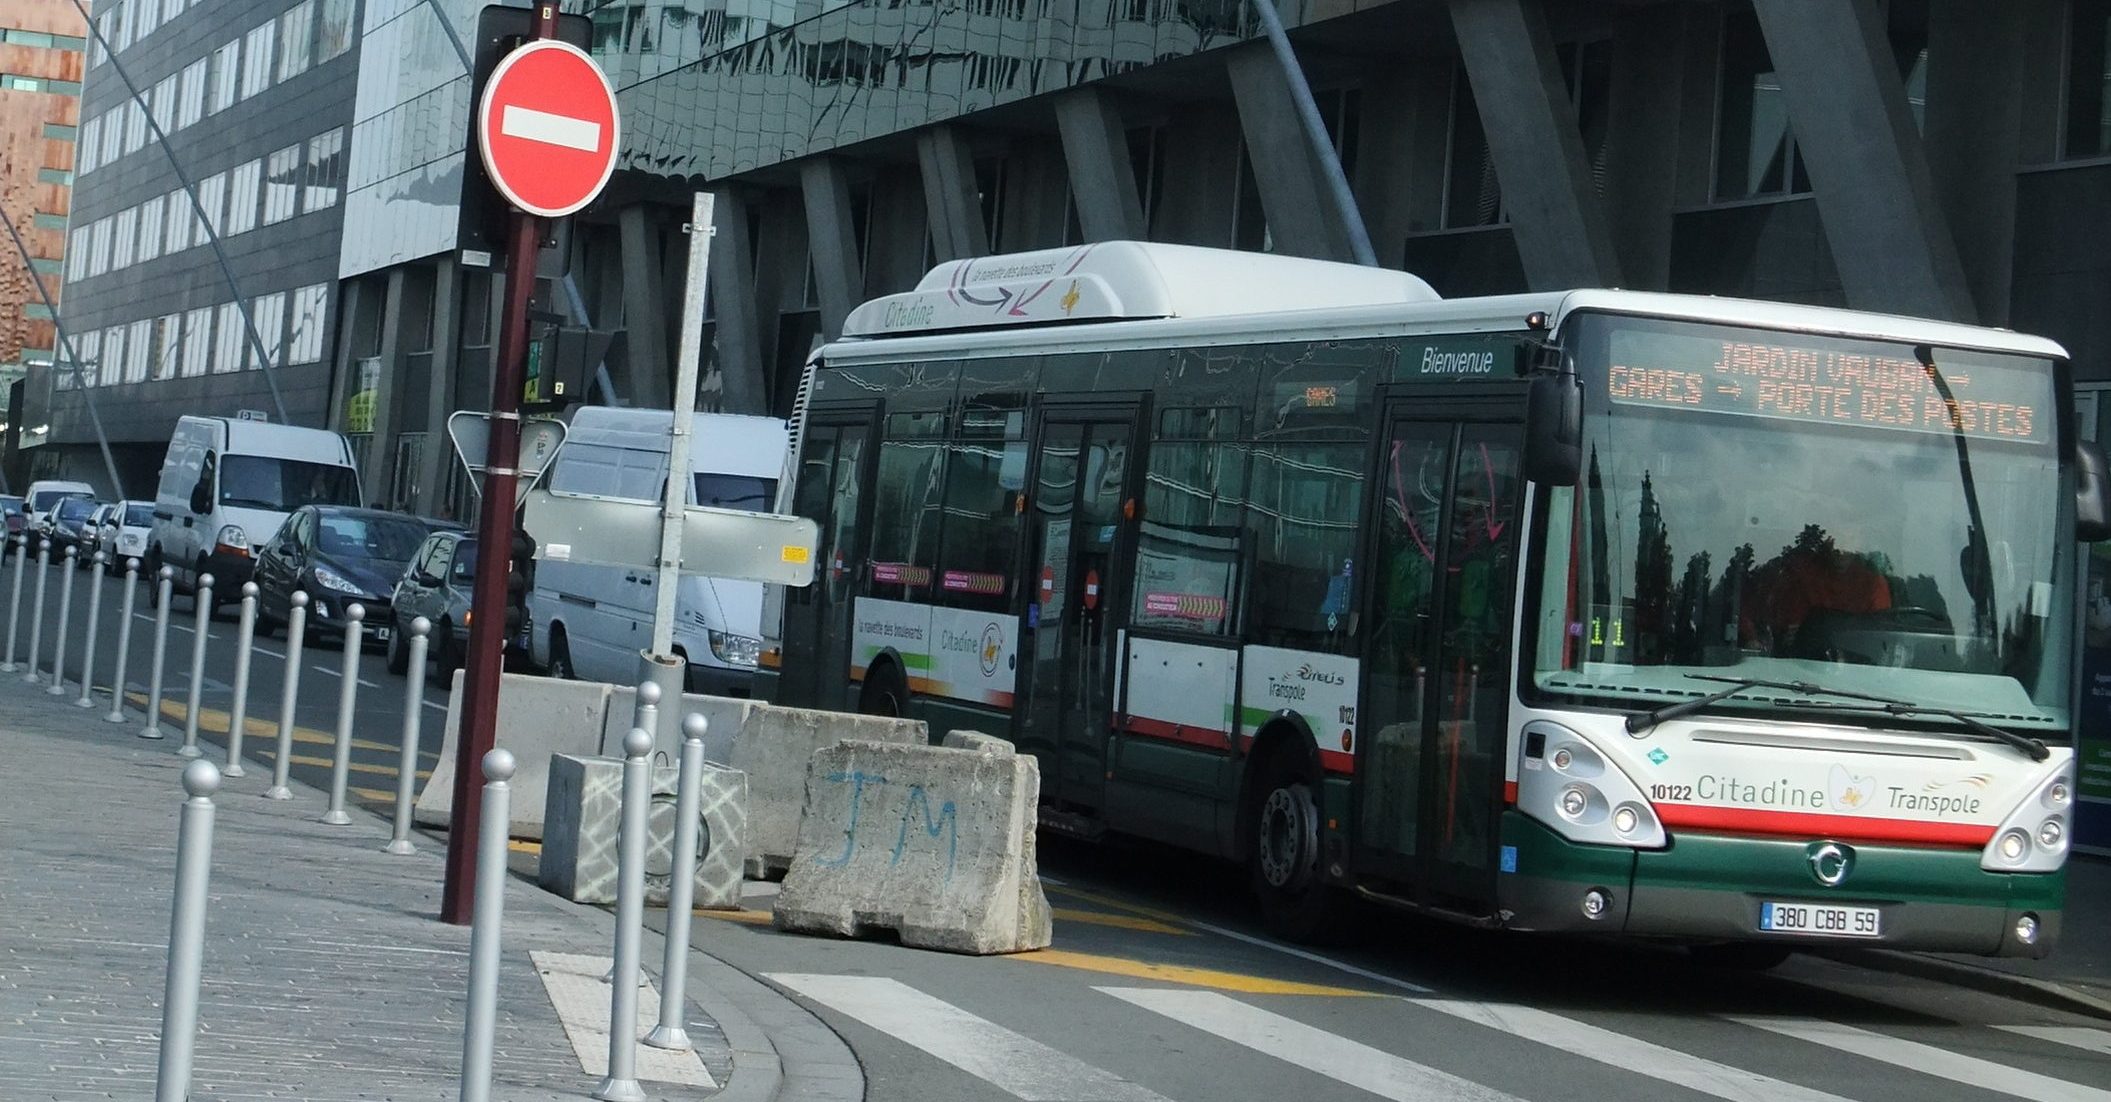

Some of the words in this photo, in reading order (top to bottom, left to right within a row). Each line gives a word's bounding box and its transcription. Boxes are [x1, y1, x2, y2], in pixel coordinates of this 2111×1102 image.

[885, 295, 934, 328] Citadine
[1420, 347, 1493, 373] Bienvenue
[1714, 343, 1818, 382] JARDIN
[1826, 353, 1936, 393] VAUBAN
[1609, 365, 1703, 404] GARES
[1758, 380, 1851, 418] PORTE
[1861, 389, 1914, 425] DES
[1924, 395, 2033, 436] POSTES
[942, 630, 978, 654] Citadine
[1268, 677, 1307, 703] Transpole
[1650, 784, 1691, 801] 10122
[1697, 774, 1824, 808] Citadine
[1888, 787, 1980, 816] Transpole
[1776, 907, 1807, 928] 380
[1815, 909, 1847, 930] CBB
[1854, 911, 1876, 932] 59
